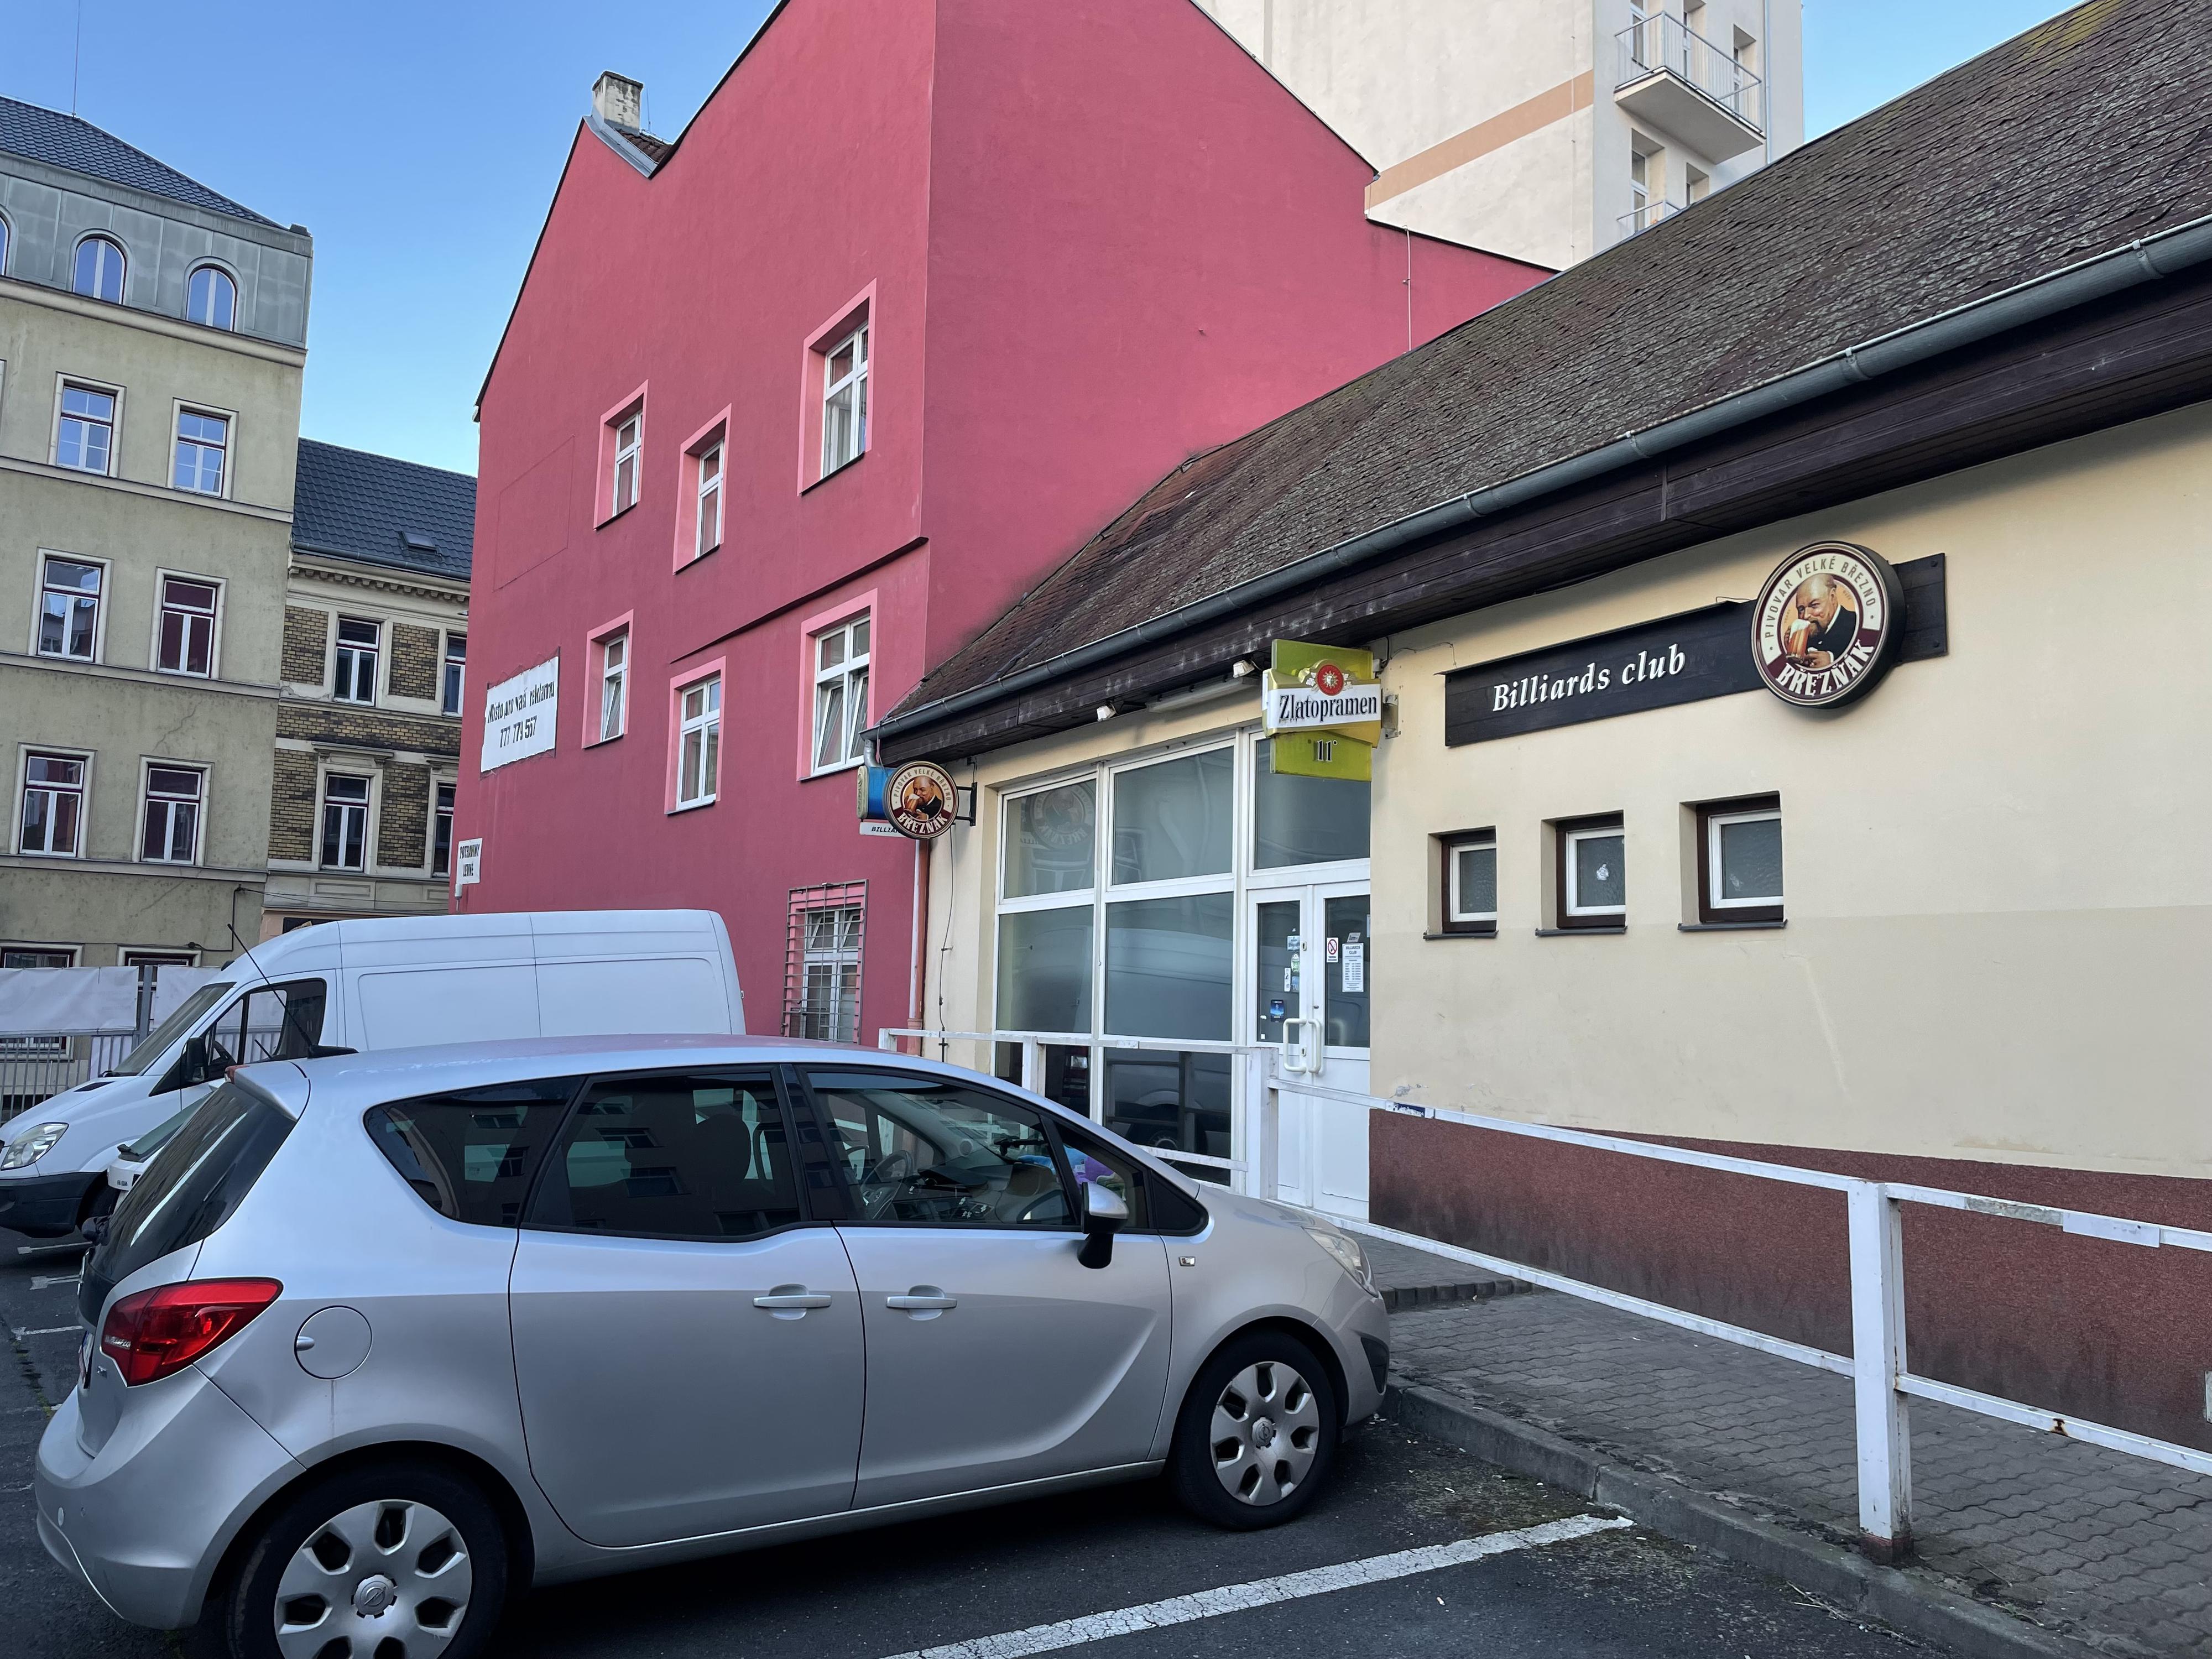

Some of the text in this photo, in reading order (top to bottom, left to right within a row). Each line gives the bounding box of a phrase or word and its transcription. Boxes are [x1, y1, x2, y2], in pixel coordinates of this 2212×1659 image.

[1765, 556, 1876, 638] PIVOVAR VELKÉ BŘEZNO
[1493, 644, 1686, 712] Billiards club
[1776, 639, 1874, 697] BŘEZŇÁK
[503, 698, 514, 719] pro
[529, 681, 555, 707] reklamu
[1279, 694, 1377, 722] Zlatopramen
[500, 726, 510, 748] 777
[894, 769, 952, 801] PIVOVAR VELKÉ BŘEZNO
[897, 812, 947, 833] BŘEZŇÁK
[460, 844, 480, 859] POTRAVINY
